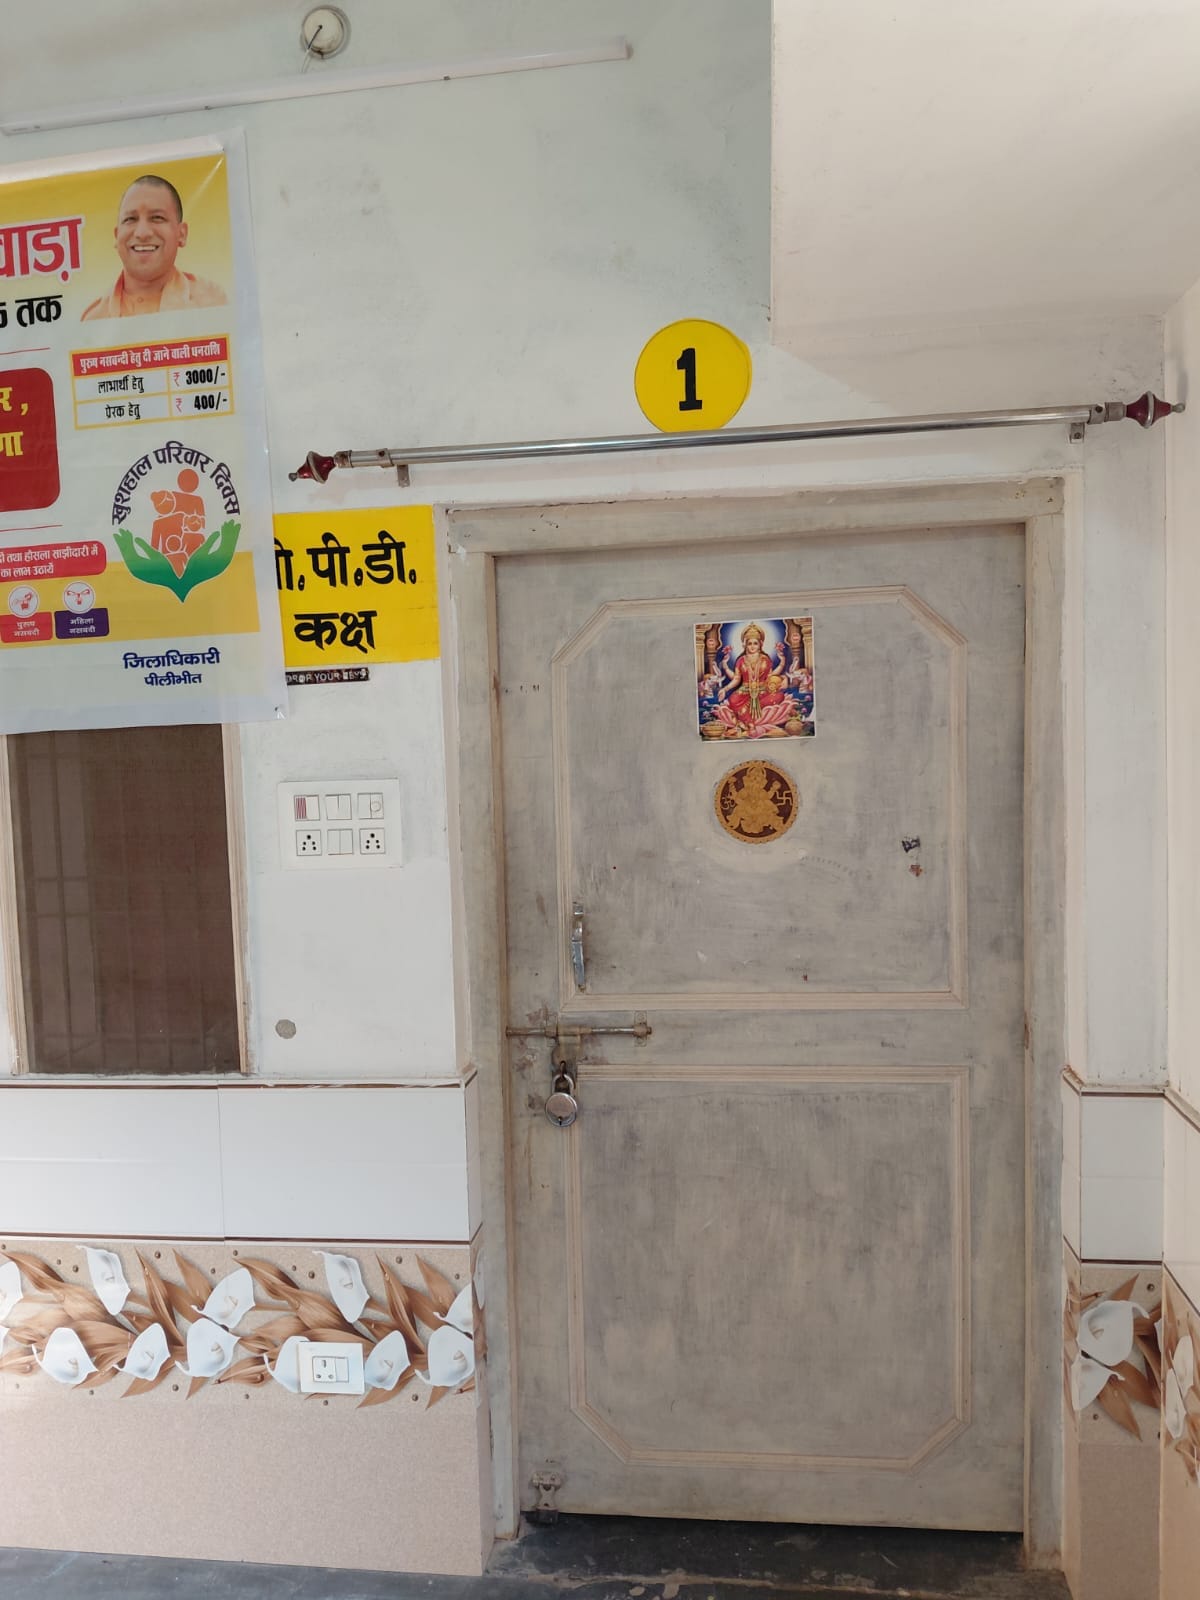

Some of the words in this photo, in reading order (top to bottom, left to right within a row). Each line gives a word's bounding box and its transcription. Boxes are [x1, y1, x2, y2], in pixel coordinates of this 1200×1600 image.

[15, 295, 63, 328] तक
[130, 350, 141, 367] हेतु
[143, 348, 151, 362] दी
[153, 347, 169, 361] जाने
[171, 344, 190, 359] वाली
[191, 341, 220, 357] धनराशि
[98, 375, 129, 393] लाभार्थी
[132, 375, 145, 393] हेतु
[185, 366, 225, 385] 3000/-
[677, 348, 702, 411] 1
[128, 402, 141, 420] हेतु
[194, 392, 227, 411] 400/-
[112, 454, 152, 525] खुशहाल
[152, 440, 214, 473] परिवार
[209, 462, 240, 515] दिवस
[7, 552, 22, 563] तथा
[1, 568, 11, 577] का
[13, 567, 31, 577] लाभ
[294, 611, 377, 654] कक्ष
[122, 647, 220, 669] जिलाधिकारी
[144, 670, 202, 686] पीलीभीत
[314, 672, 340, 682] YOUR
